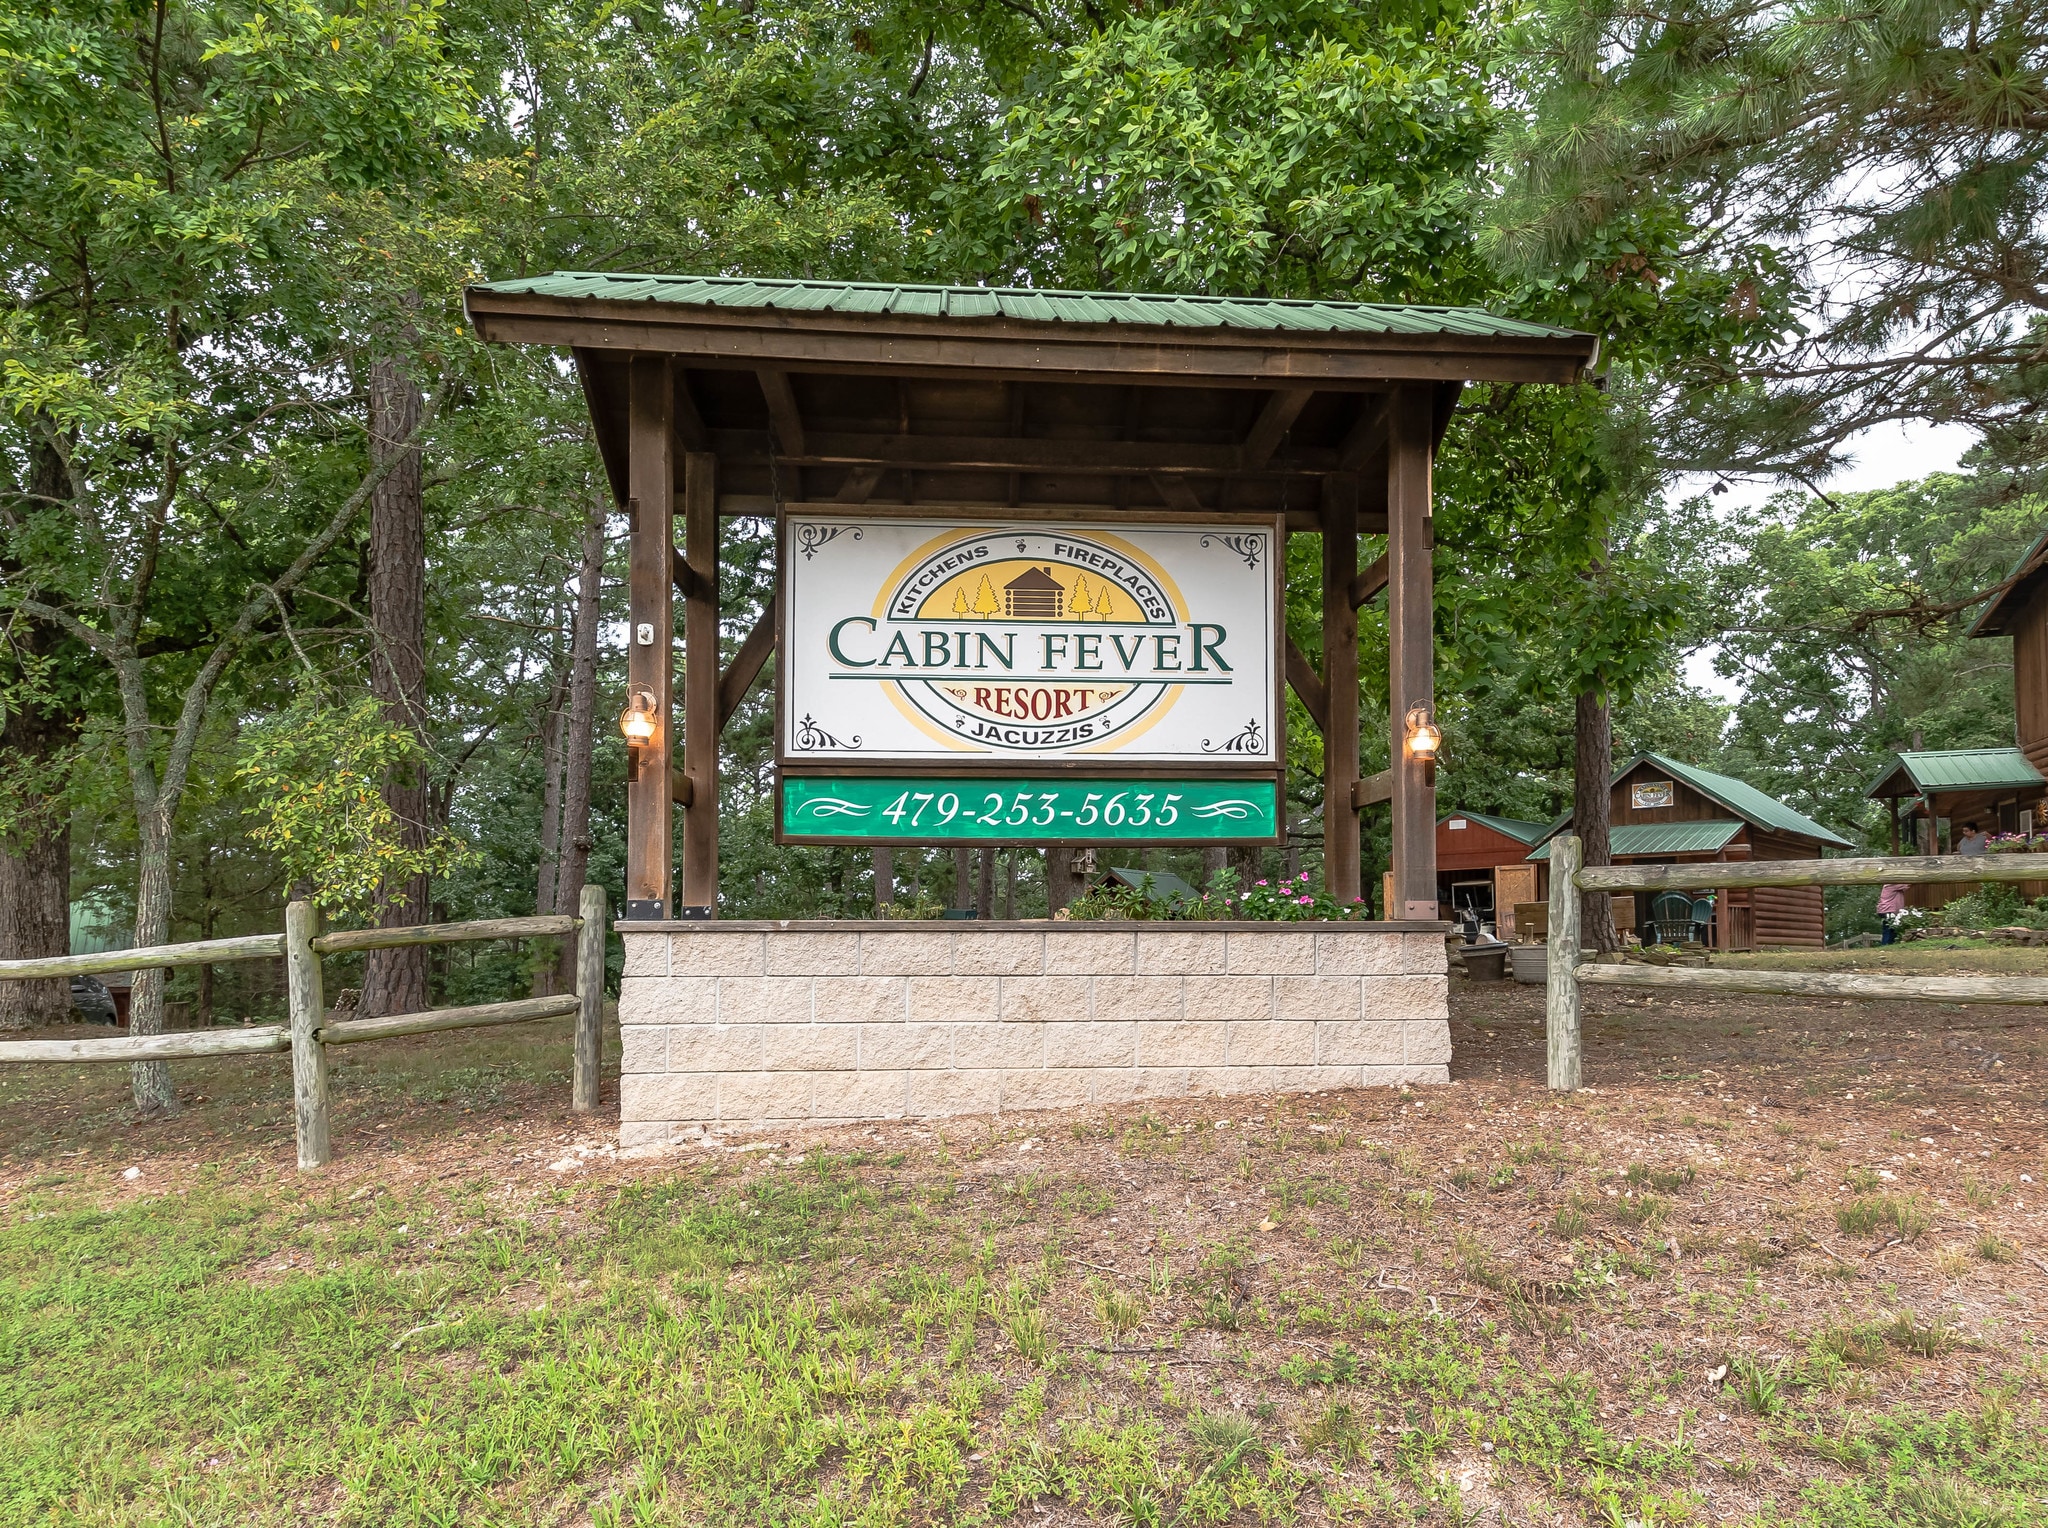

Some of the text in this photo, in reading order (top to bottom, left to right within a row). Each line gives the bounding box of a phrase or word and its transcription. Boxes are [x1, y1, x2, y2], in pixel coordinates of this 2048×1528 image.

[897, 543, 1166, 620] KITCHENS FIREPLACES
[828, 617, 1234, 673] CABIN FEVER
[974, 687, 1095, 721] RESORT
[970, 722, 1094, 745] JACUZZIS
[881, 792, 1184, 826] 479-253-5635
